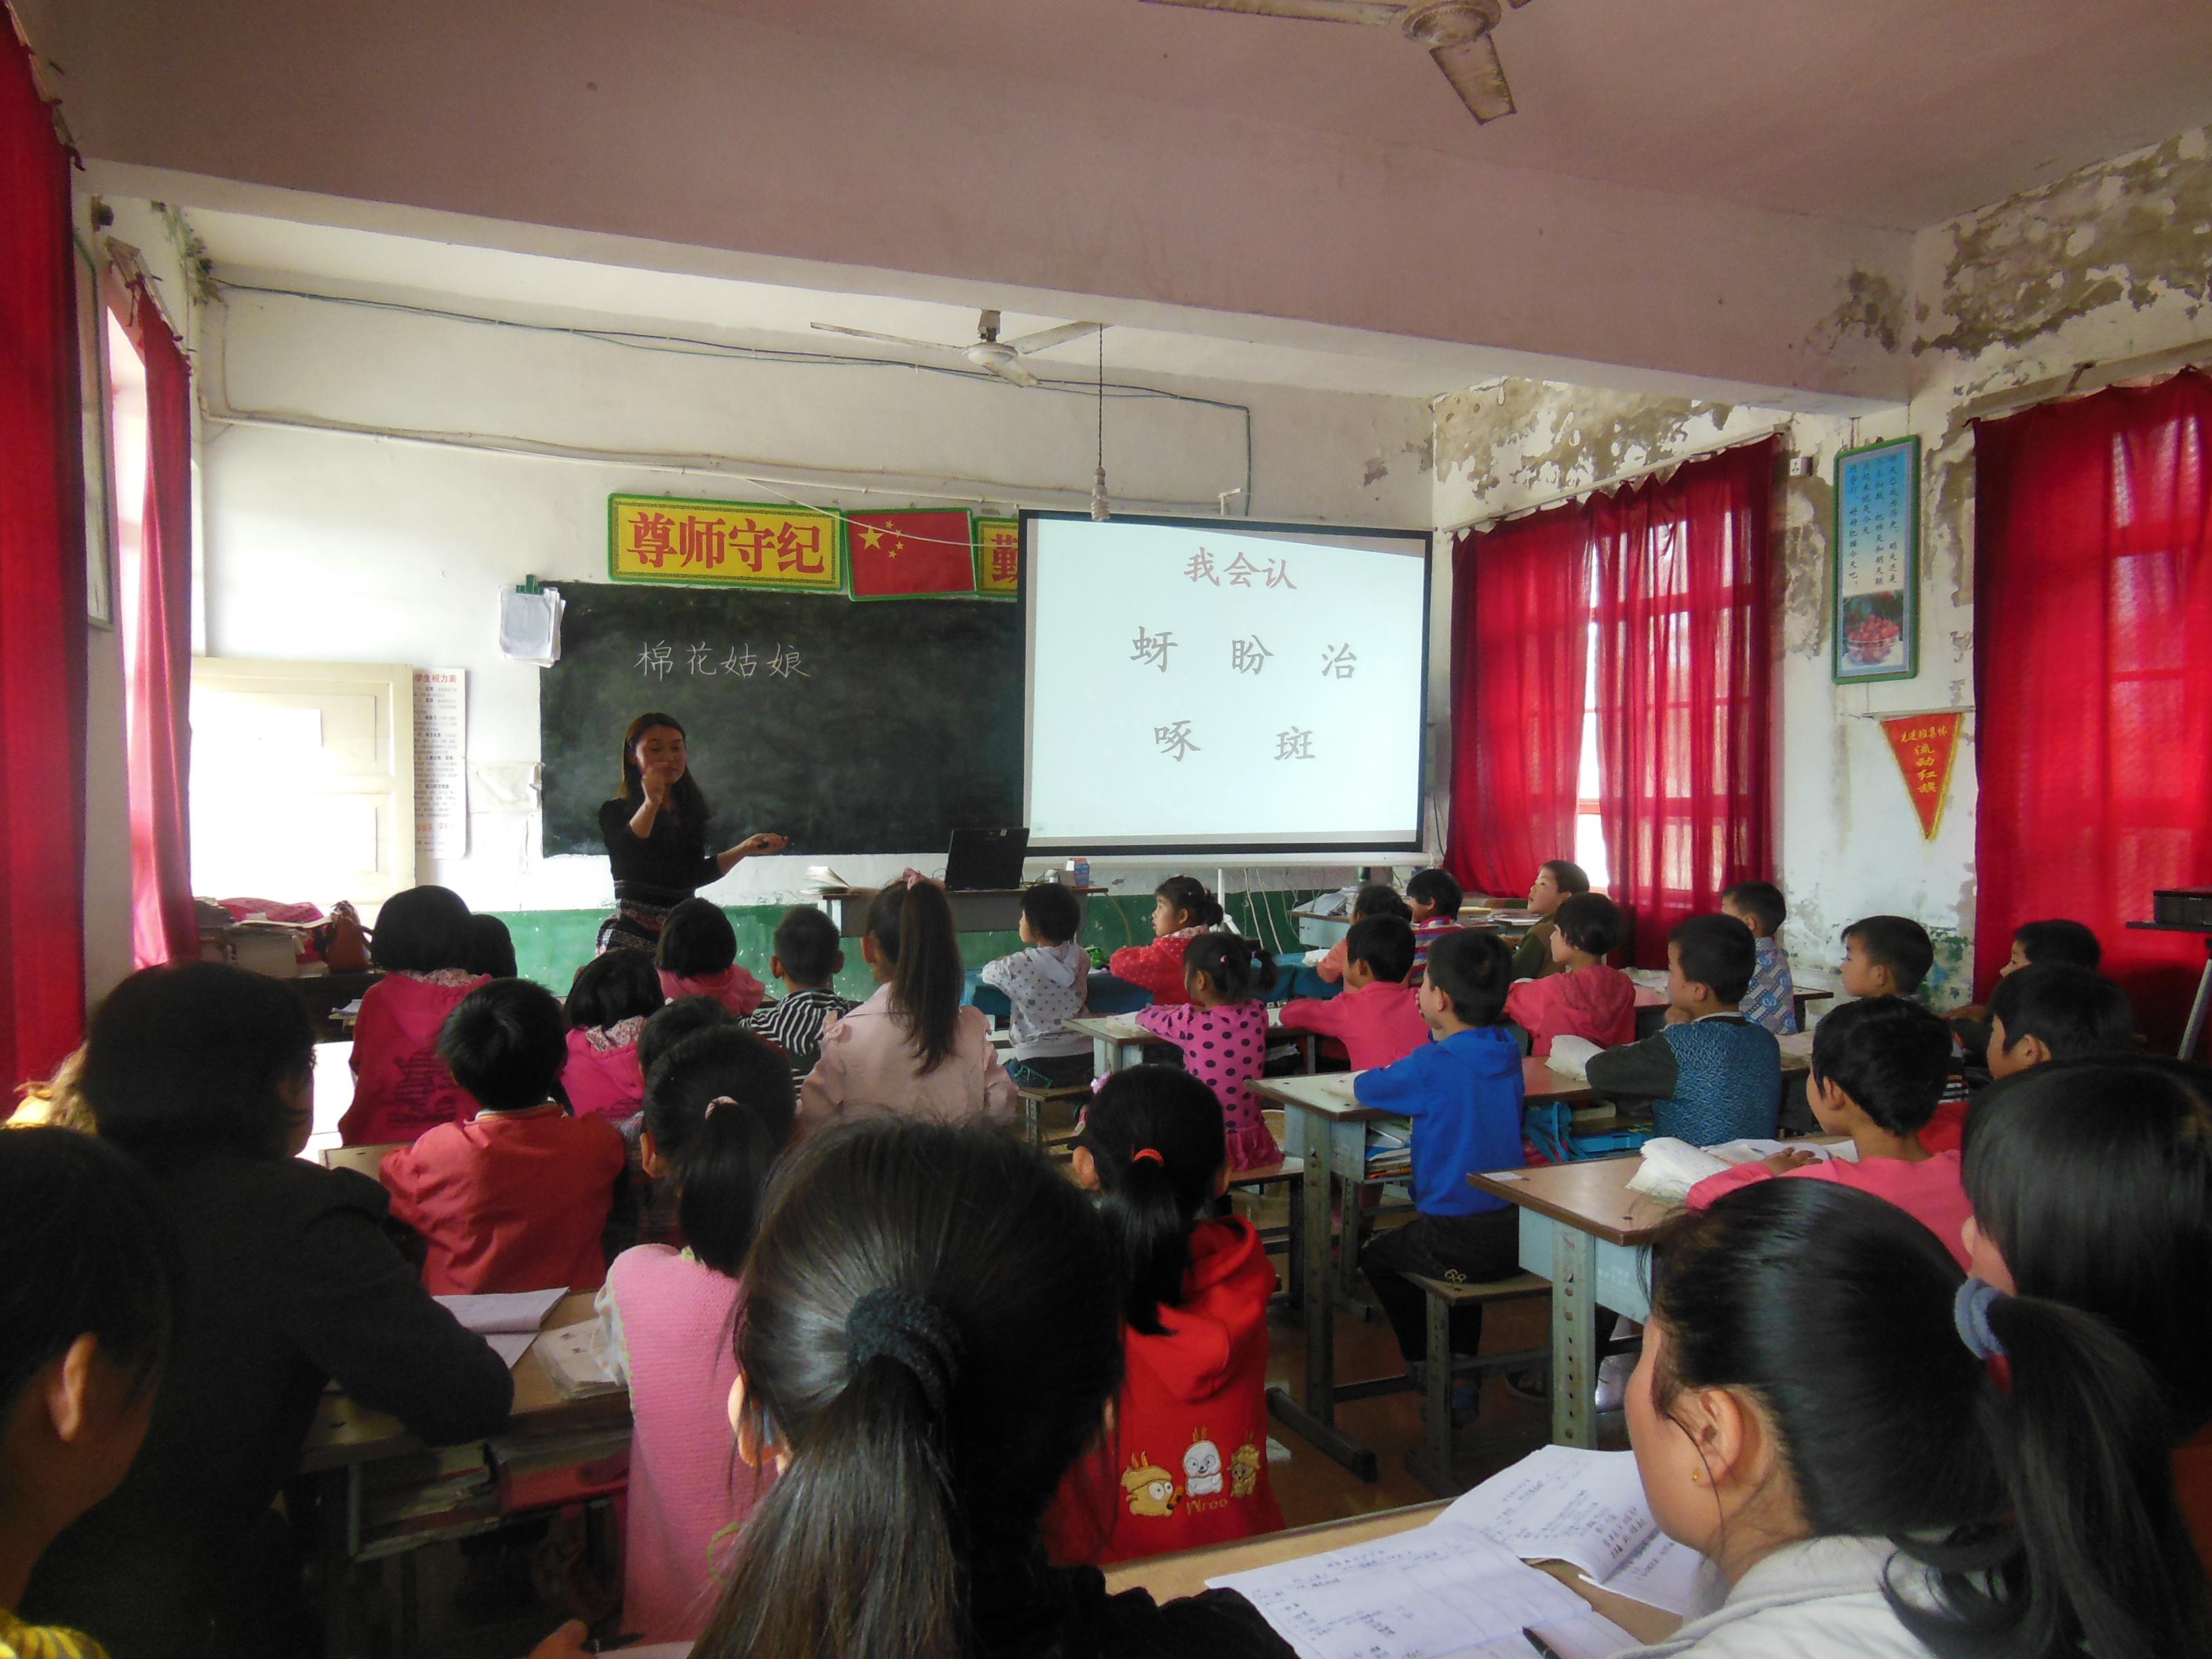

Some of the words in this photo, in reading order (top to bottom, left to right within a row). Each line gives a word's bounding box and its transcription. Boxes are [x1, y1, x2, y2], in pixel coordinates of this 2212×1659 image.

[627, 511, 825, 574] 尊师守纪
[1183, 546, 1298, 590] 我会认
[634, 639, 811, 682] 棉花姑娘
[1130, 626, 1179, 672] 蚜
[1231, 634, 1274, 676] 盼
[1322, 642, 1357, 680] 治
[1154, 720, 1202, 762] 啄
[1273, 726, 1315, 761] 斑
[1900, 725, 1948, 743] 先进班集体
[1914, 743, 1938, 793] 流动红旗
